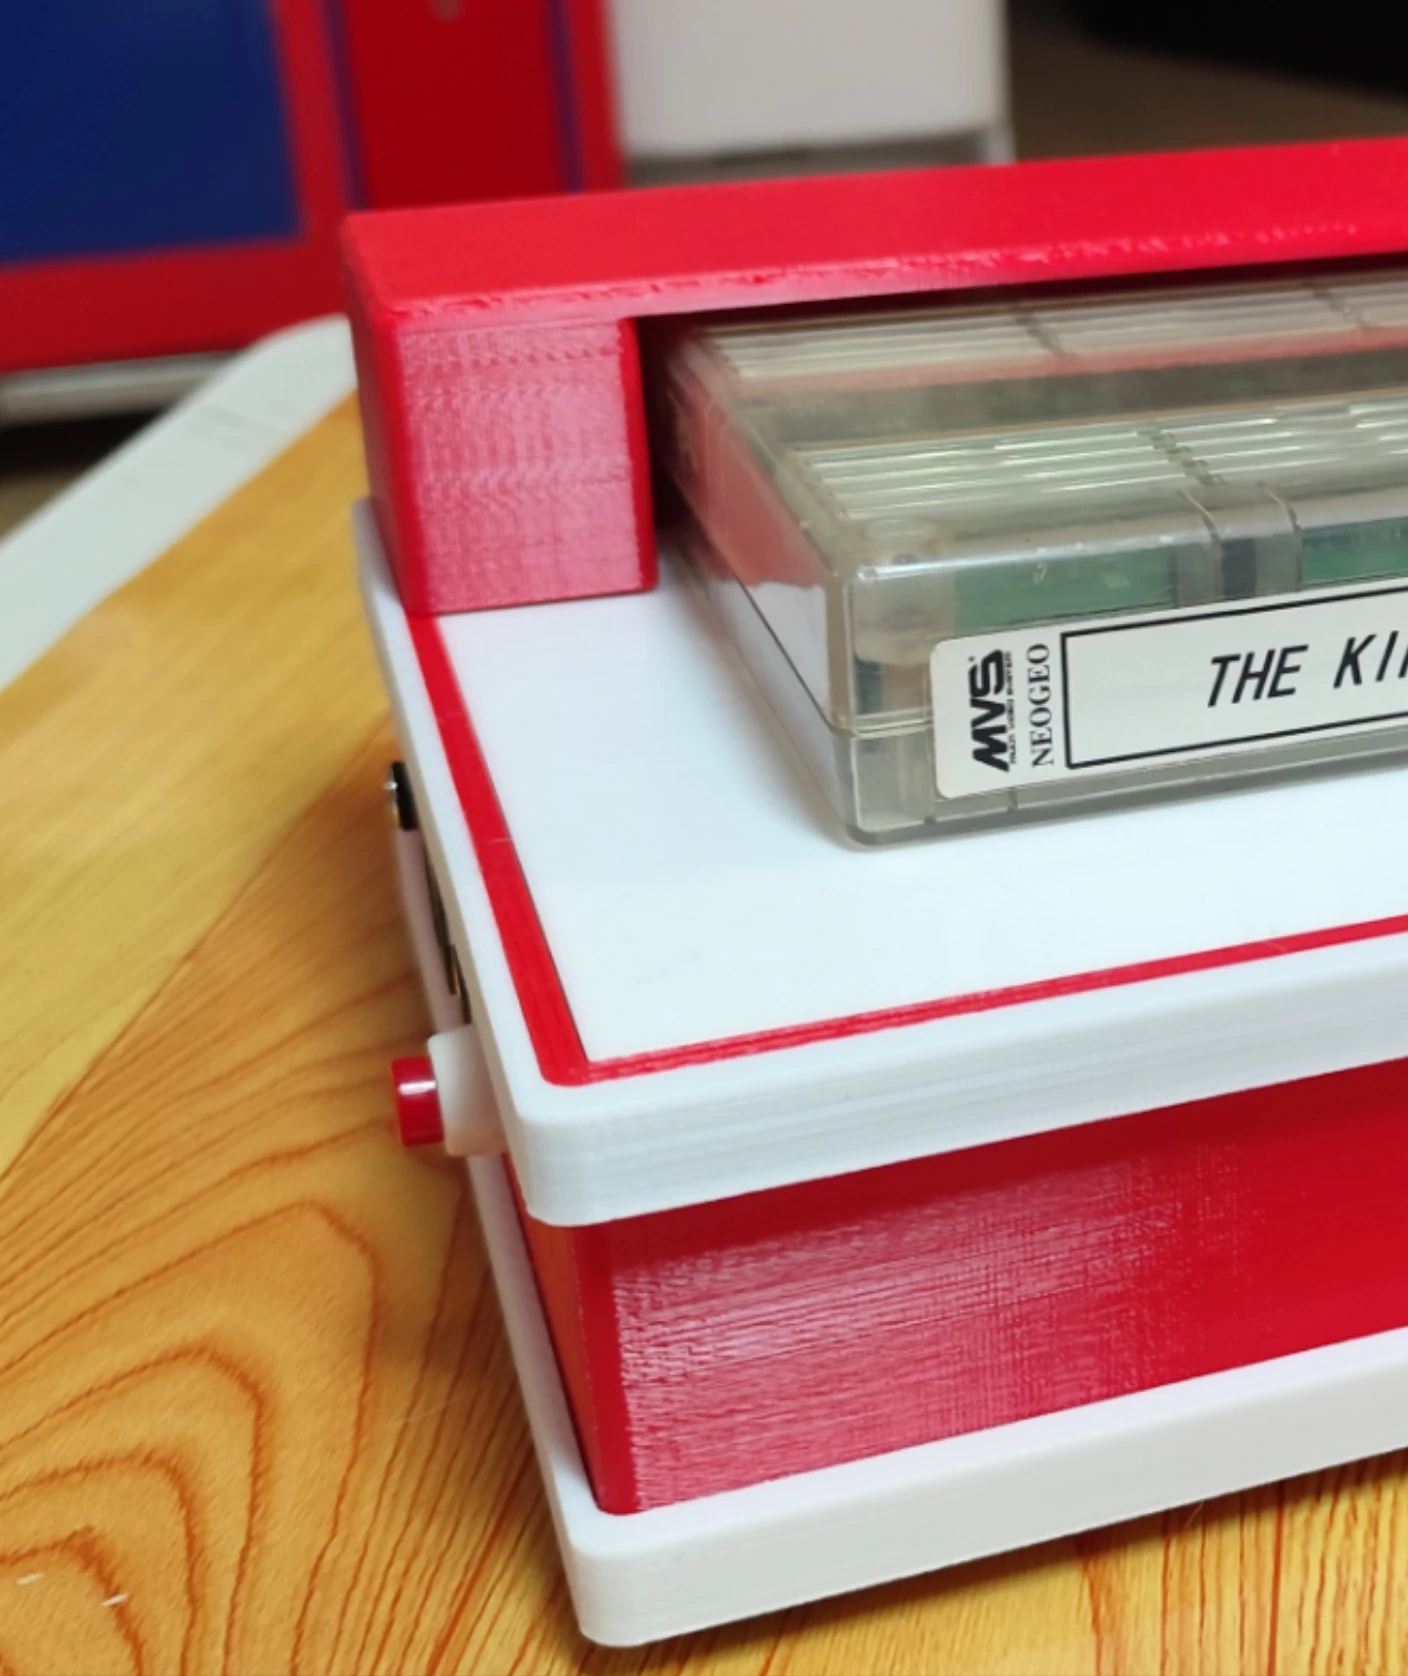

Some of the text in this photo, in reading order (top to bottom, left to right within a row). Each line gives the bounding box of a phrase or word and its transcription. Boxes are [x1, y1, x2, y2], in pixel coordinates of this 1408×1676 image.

[968, 649, 1010, 773] MVS
[1027, 643, 1054, 768] NEOGEO
[1207, 644, 1309, 707] THE
